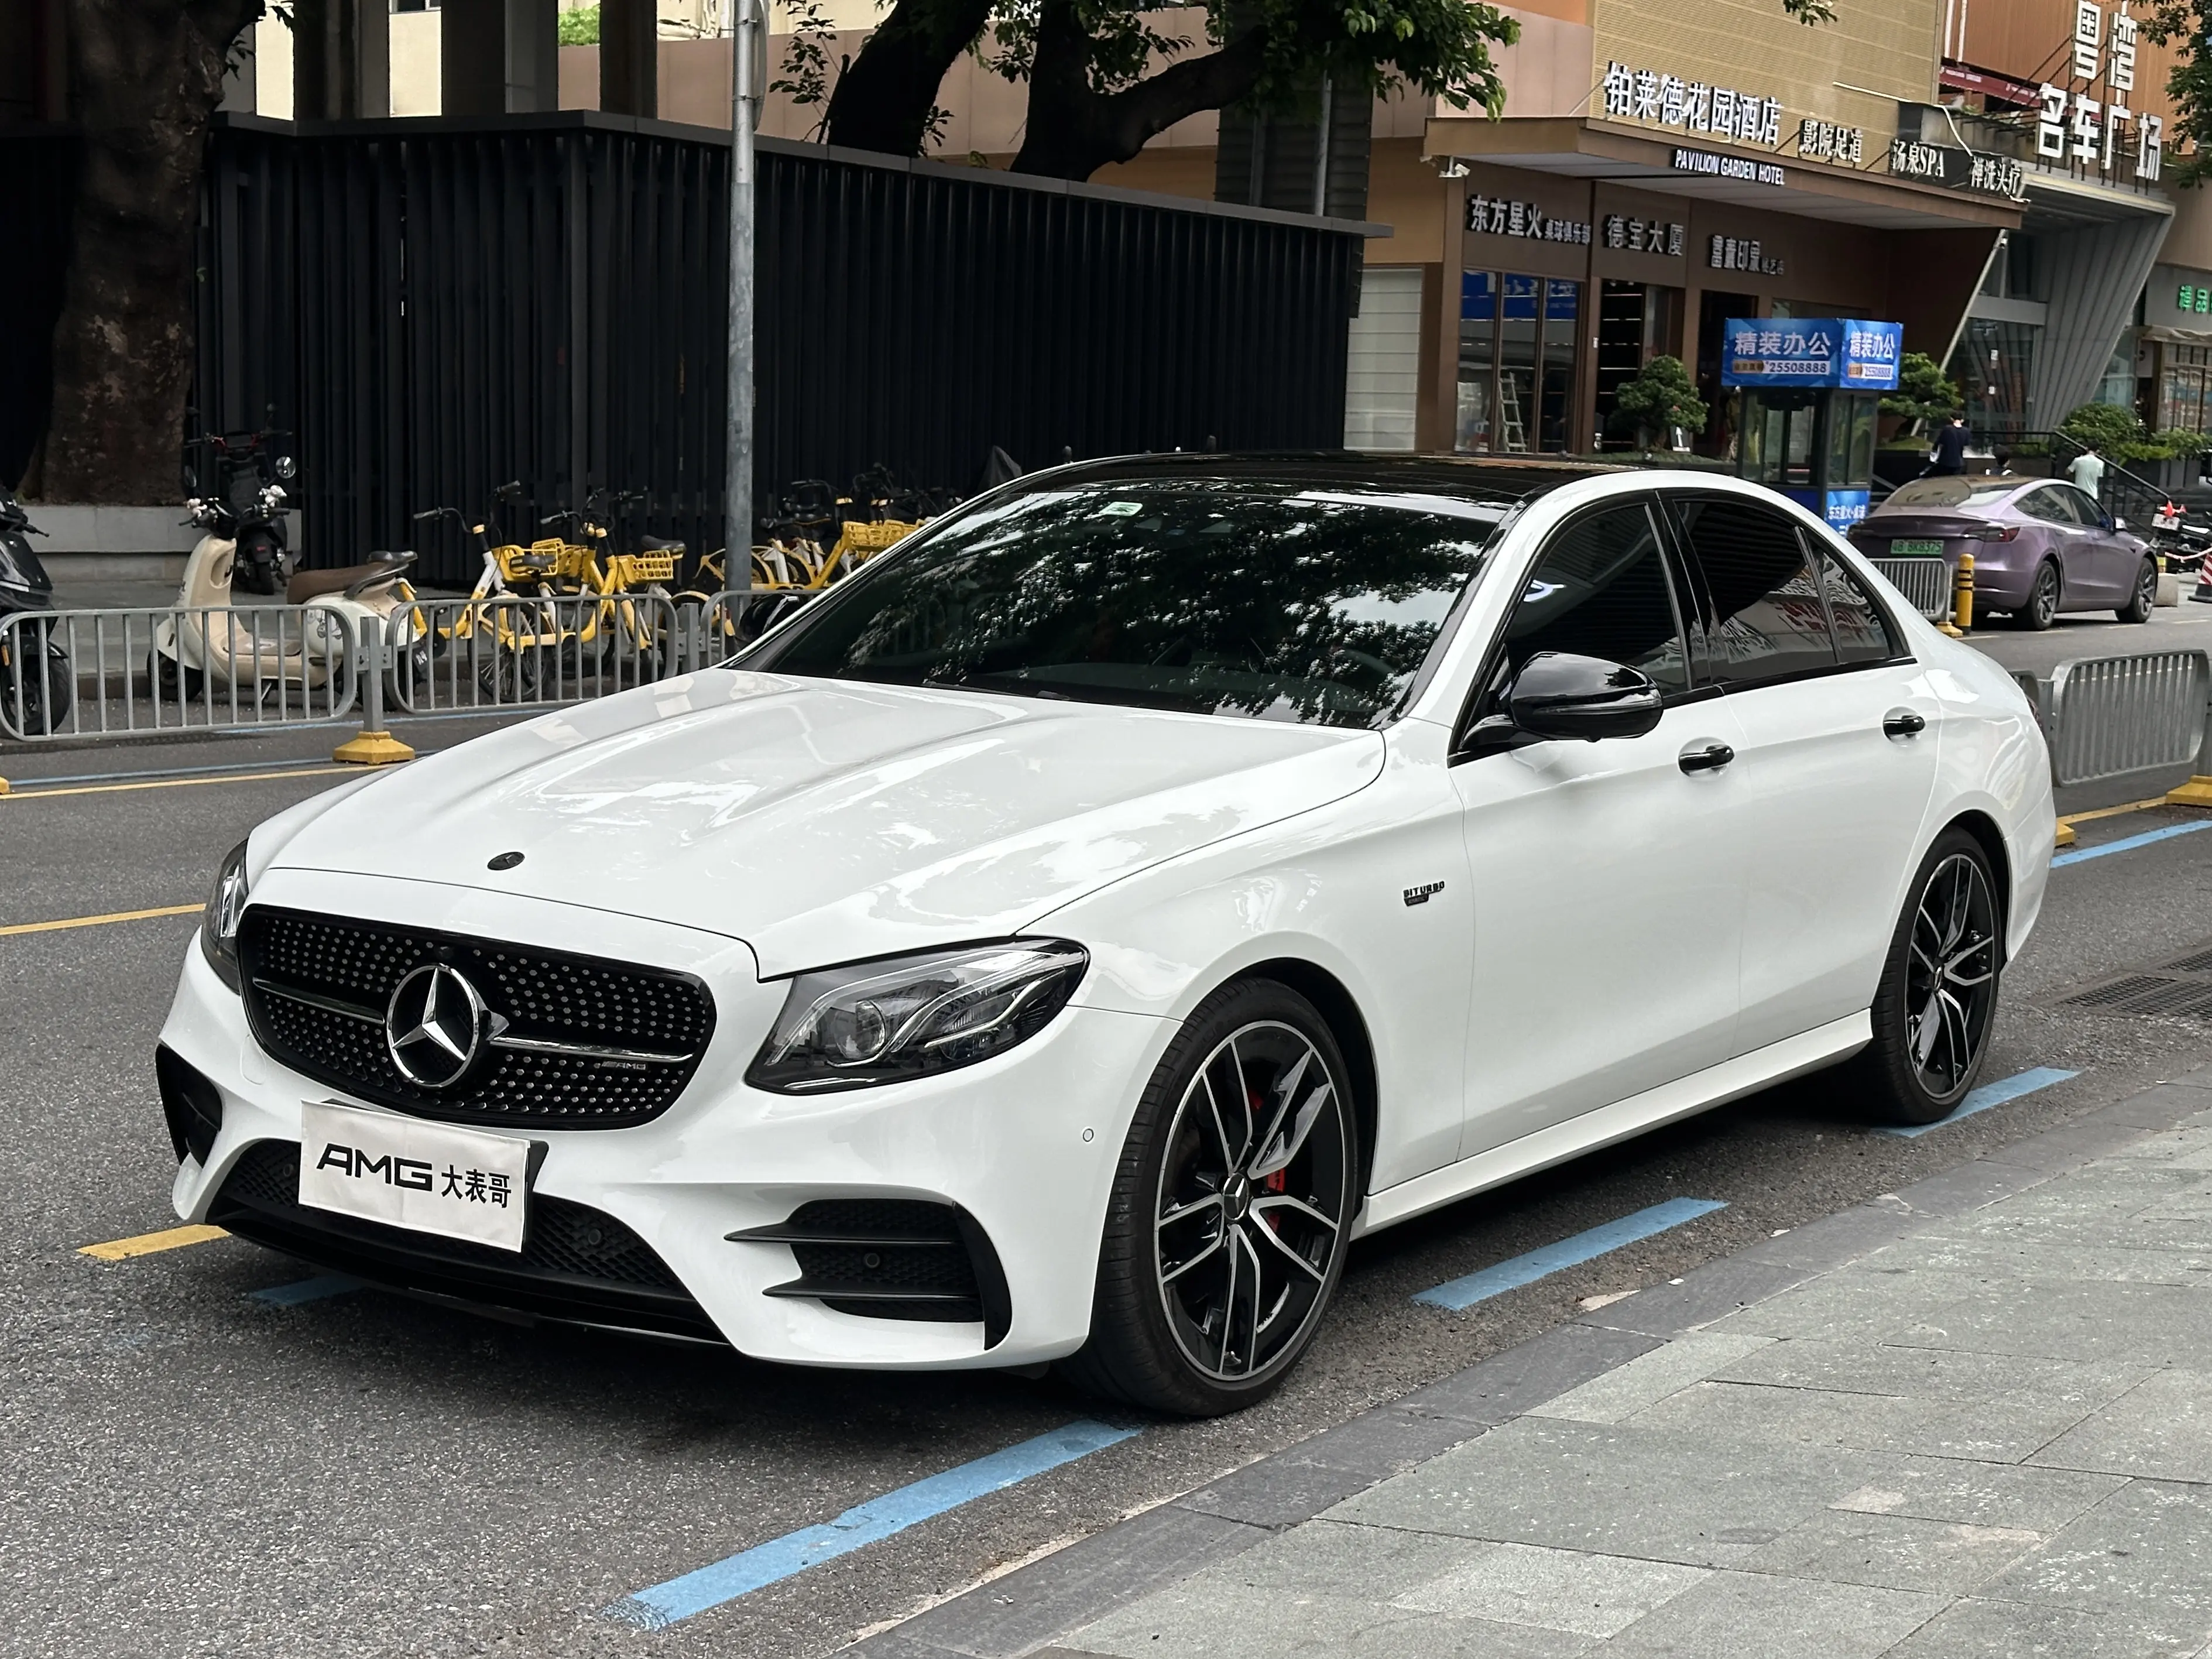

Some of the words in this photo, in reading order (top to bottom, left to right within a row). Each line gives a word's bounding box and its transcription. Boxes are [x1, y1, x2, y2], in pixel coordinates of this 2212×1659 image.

[2076, 0, 2138, 91] 粤湾
[1603, 61, 1784, 145] 铂莱德花园酒店
[2038, 82, 2163, 181] 名车广场
[1675, 149, 1720, 174] PAVILION
[1720, 157, 1757, 180] GARDEN
[1758, 164, 1785, 185] HOTEL
[1893, 138, 1945, 177] 汤泉SPA
[1608, 214, 1684, 256] 德宝大厦
[1734, 331, 1831, 357] 精装办公
[1850, 331, 1895, 359] 精装办公
[1769, 362, 1827, 373] 25508888
[1403, 880, 1445, 898] BITURBO
[316, 1143, 433, 1192] AMG
[441, 1164, 512, 1208] 大表哥
